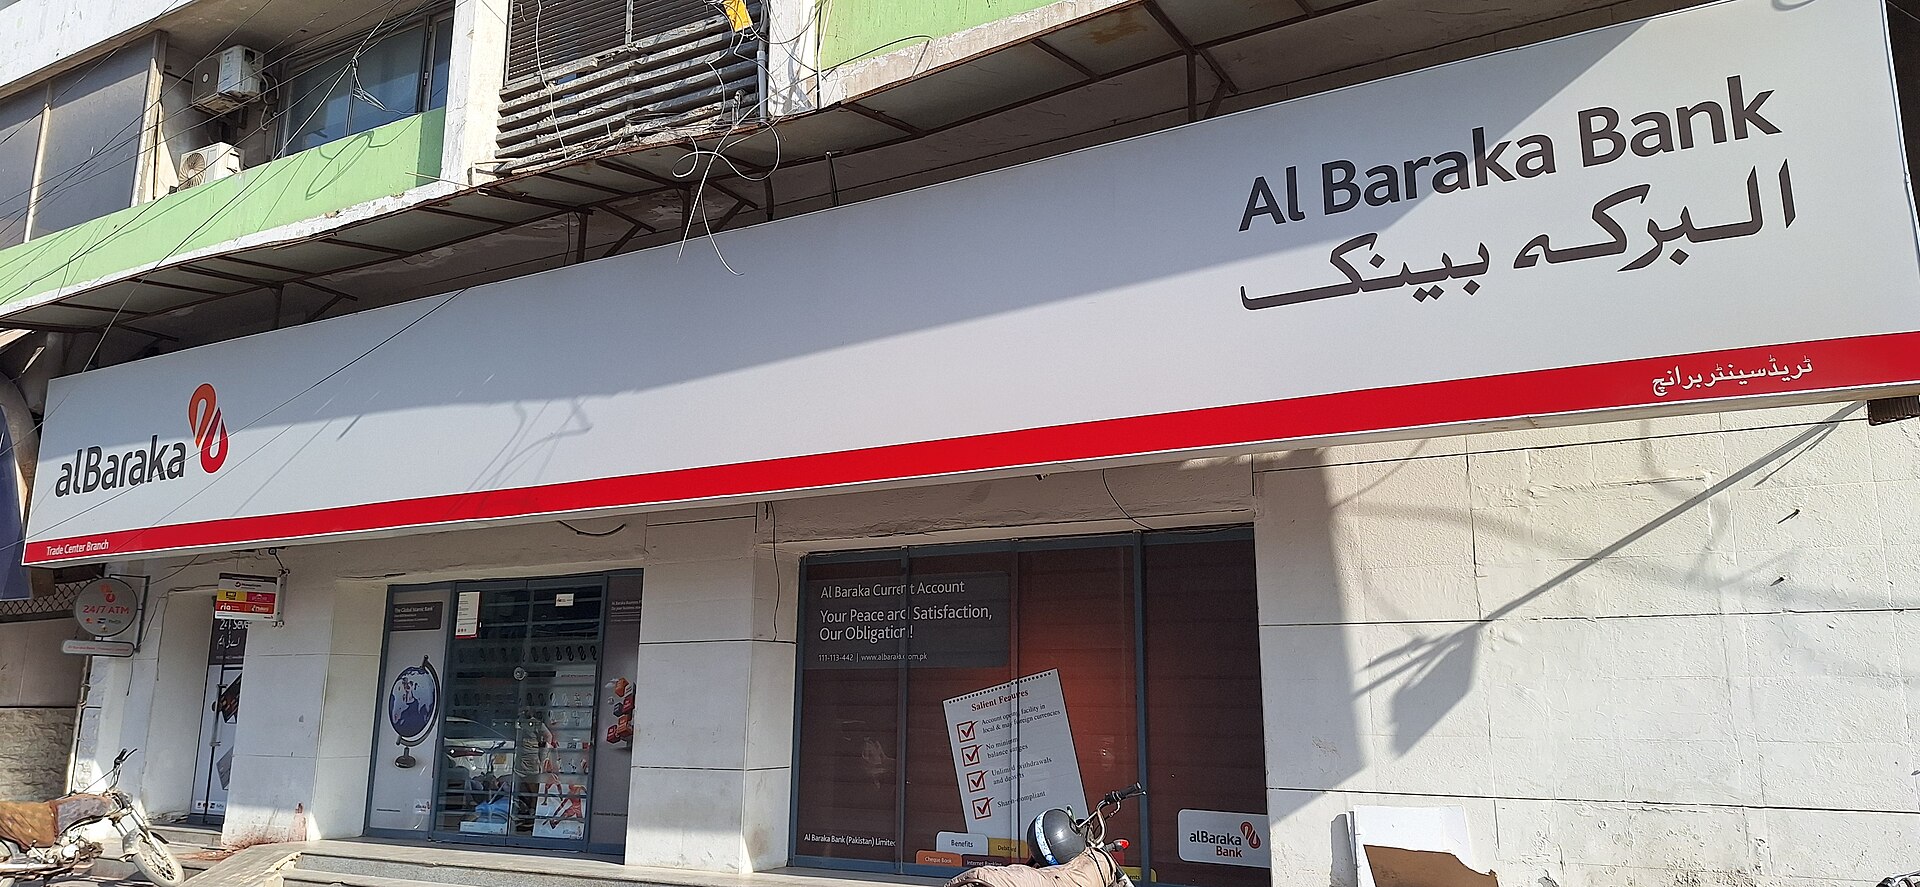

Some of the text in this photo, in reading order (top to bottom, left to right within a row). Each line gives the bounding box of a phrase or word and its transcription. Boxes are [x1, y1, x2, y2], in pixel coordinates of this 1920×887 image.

[1238, 74, 1782, 232] Al Baraka Bank
[1239, 233, 1490, 311] بینک
[55, 434, 187, 498] alBaraka
[46, 538, 109, 556] Trade Center Branch
[820, 586, 832, 599] Al
[834, 584, 870, 599] Baraka
[917, 580, 965, 594] Account
[83, 605, 130, 615] 24/7 ATM
[219, 602, 232, 611] ria
[820, 608, 848, 623] Your
[850, 607, 884, 622] Peace
[913, 603, 993, 621] Satisfaction,
[819, 626, 843, 641] Our
[818, 653, 854, 662] 111-113-442
[971, 699, 997, 713] Salient
[981, 714, 1003, 725] Account
[982, 725, 996, 734] local
[996, 723, 1001, 731] &
[987, 749, 1009, 759] balance
[993, 777, 1004, 785] and
[804, 833, 811, 841] Al
[811, 834, 831, 843] Baraka
[831, 835, 845, 844] Bank
[846, 836, 875, 847] (Pakistan)
[951, 839, 974, 848] Benefits
[1189, 830, 1242, 846] alBaraka
[1216, 845, 1243, 858] Bank
[924, 856, 941, 864] Cheque
